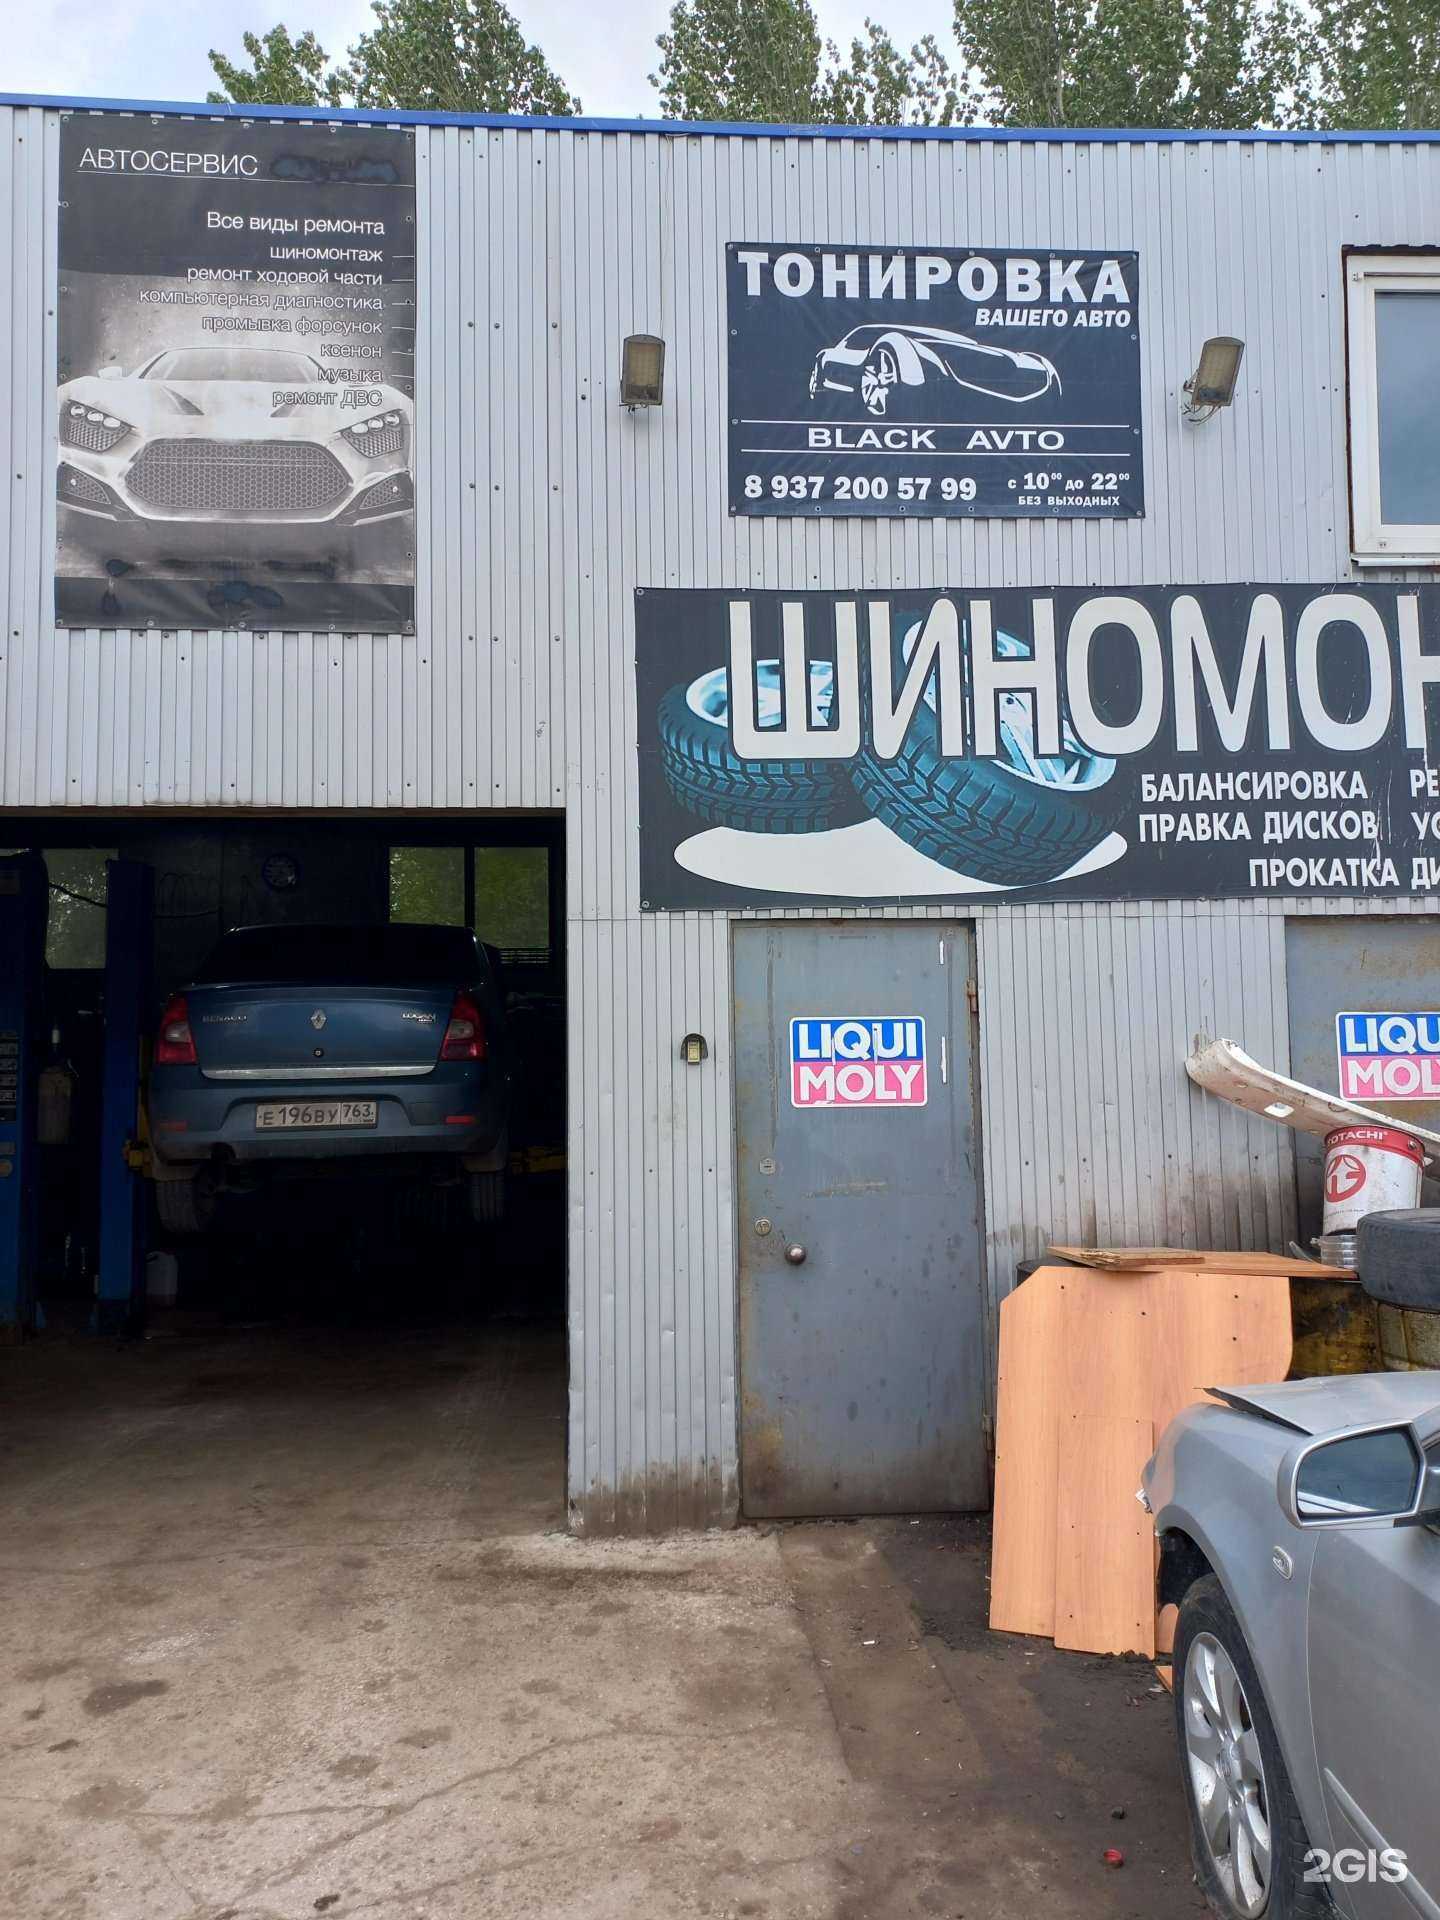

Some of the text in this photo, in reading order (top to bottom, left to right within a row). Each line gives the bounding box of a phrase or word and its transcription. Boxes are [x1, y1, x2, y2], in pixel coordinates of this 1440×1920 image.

[79, 148, 258, 176] АВТОСЕРВИС
[207, 212, 385, 236] Все виды ремонта
[270, 247, 383, 262] шиномонтаж
[187, 268, 383, 285] ремонт ходовой части
[737, 251, 1131, 303] ТОНИРОВКА
[140, 290, 383, 311] компьютерная диагностика
[202, 317, 383, 335] промывка форсунок
[975, 308, 1131, 328] ВАШЕГО АВТО
[320, 344, 383, 358] ксенон
[317, 368, 383, 384] музыка
[273, 390, 383, 408] ремонт ДВС
[808, 427, 1065, 450] BLACK AVTO
[744, 475, 977, 501] 8 937 200 57 99
[1065, 480, 1084, 491] до
[1018, 496, 1120, 507] БЕЗ ВЫХОДНЫХ
[1141, 770, 1369, 802] БАЛАНСИРОВКА
[1409, 769, 1440, 797] РЕ
[1139, 810, 1378, 844] ПРАВКА ДИСКОВ
[1249, 858, 1400, 887] ПРОКАТКА
[798, 1022, 917, 1061] LIQUI
[1344, 1016, 1440, 1054] LIQU
[799, 1064, 922, 1101] MOLY
[1347, 1058, 1440, 1095] MOL
[343, 1104, 371, 1118] 763
